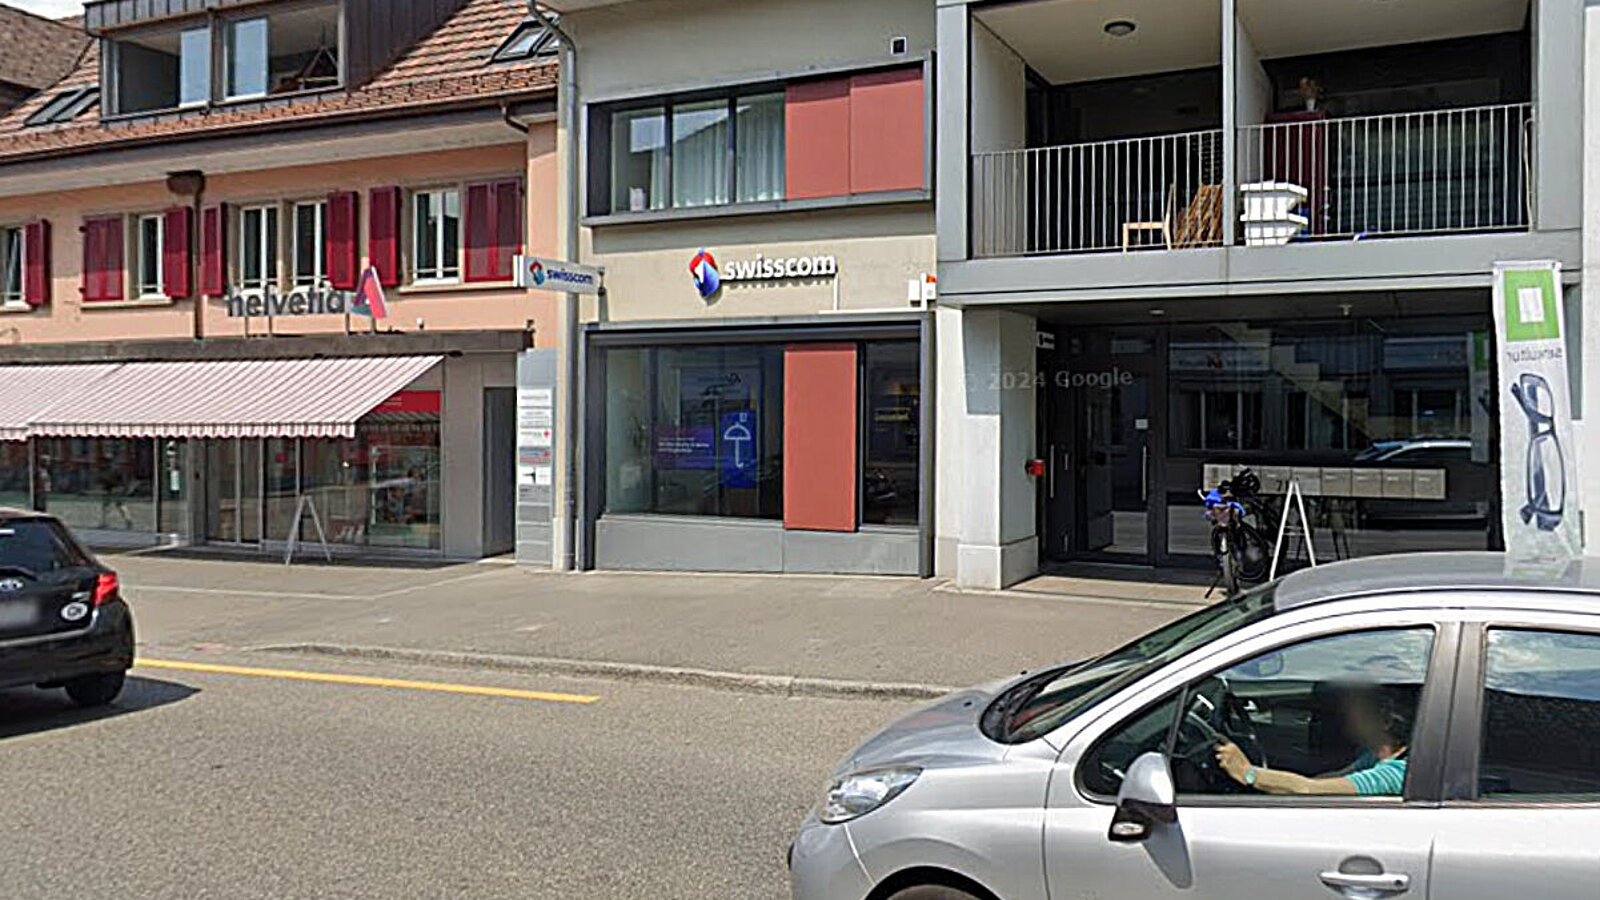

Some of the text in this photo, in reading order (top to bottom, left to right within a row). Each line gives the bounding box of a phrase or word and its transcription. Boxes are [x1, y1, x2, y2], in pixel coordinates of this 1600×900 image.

[546, 268, 594, 284] swisscom
[725, 253, 836, 281] swisscom
[227, 284, 346, 317] helvetia
